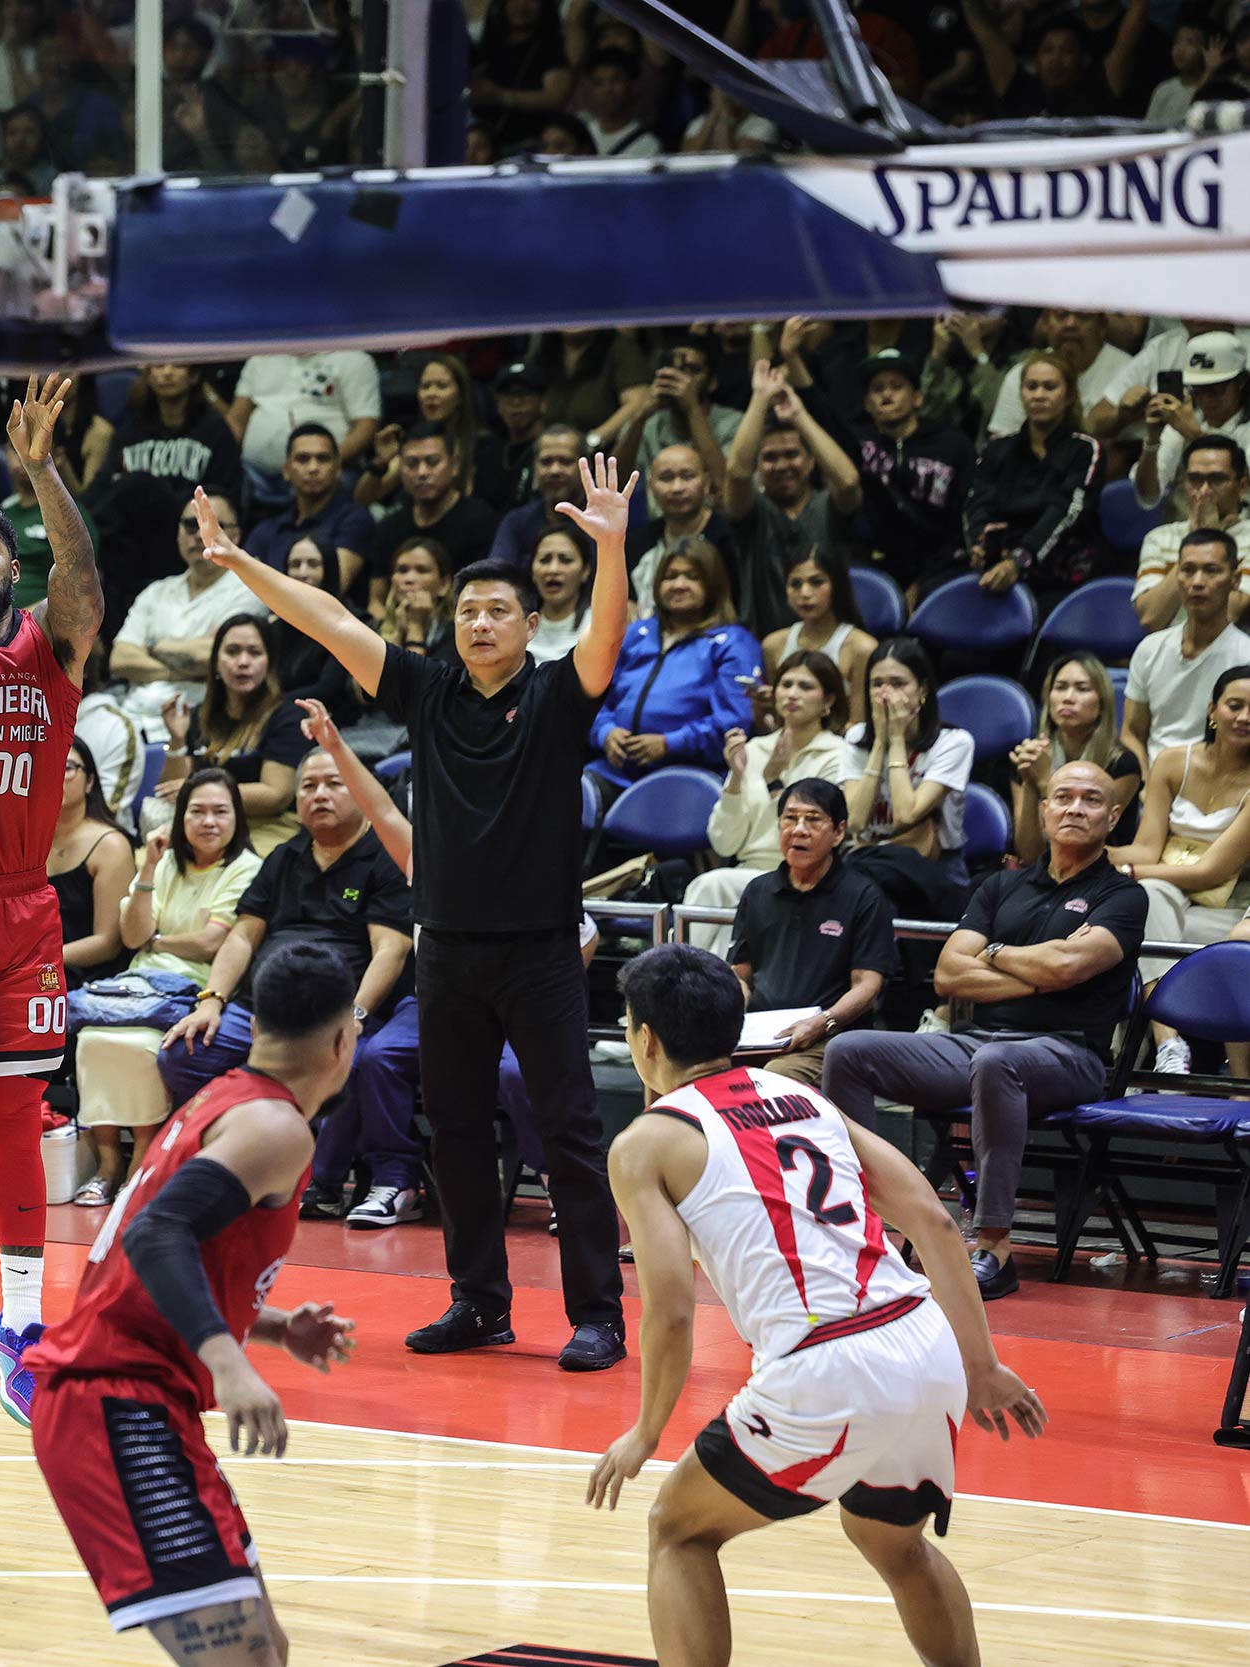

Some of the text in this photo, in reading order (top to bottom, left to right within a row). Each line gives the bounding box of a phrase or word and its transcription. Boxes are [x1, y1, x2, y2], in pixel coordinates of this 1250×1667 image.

[871, 148, 1221, 238] SPALDING
[9, 725, 47, 742] MIGUE
[27, 995, 66, 1034] 00
[775, 1134, 860, 1226] 2
